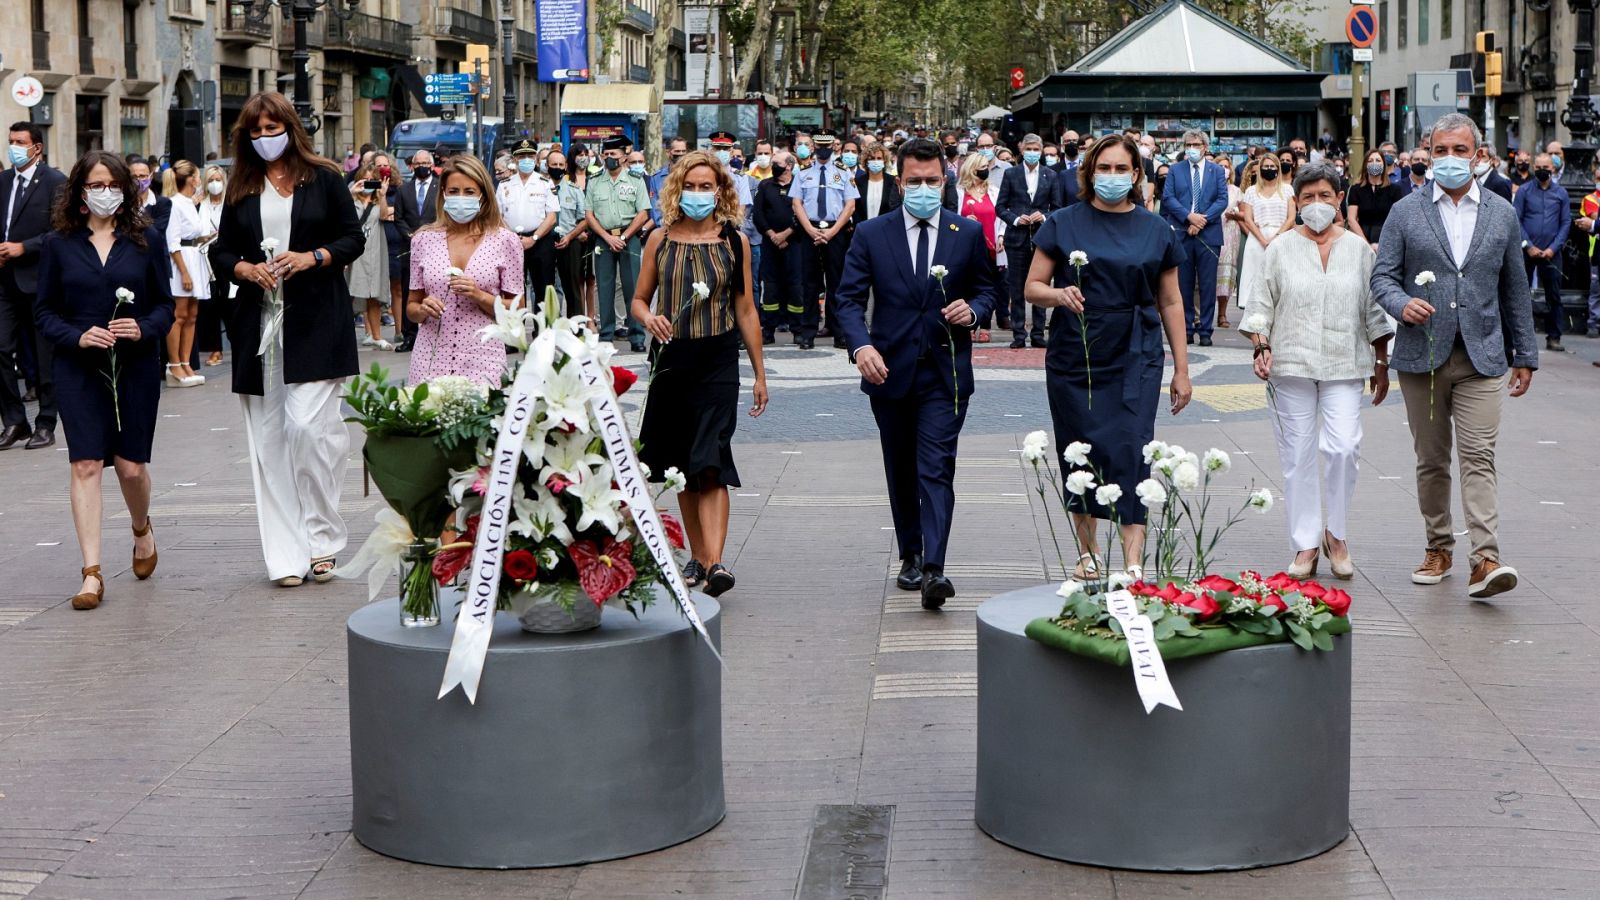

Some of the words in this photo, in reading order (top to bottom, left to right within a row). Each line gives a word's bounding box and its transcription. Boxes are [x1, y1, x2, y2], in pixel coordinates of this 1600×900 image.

[472, 494, 506, 624] ASOCIACIÓN
[497, 449, 513, 485] 11M
[510, 392, 529, 435] CON
[599, 400, 640, 499] VICTIMAS
[634, 508, 675, 585] AGOSTO
